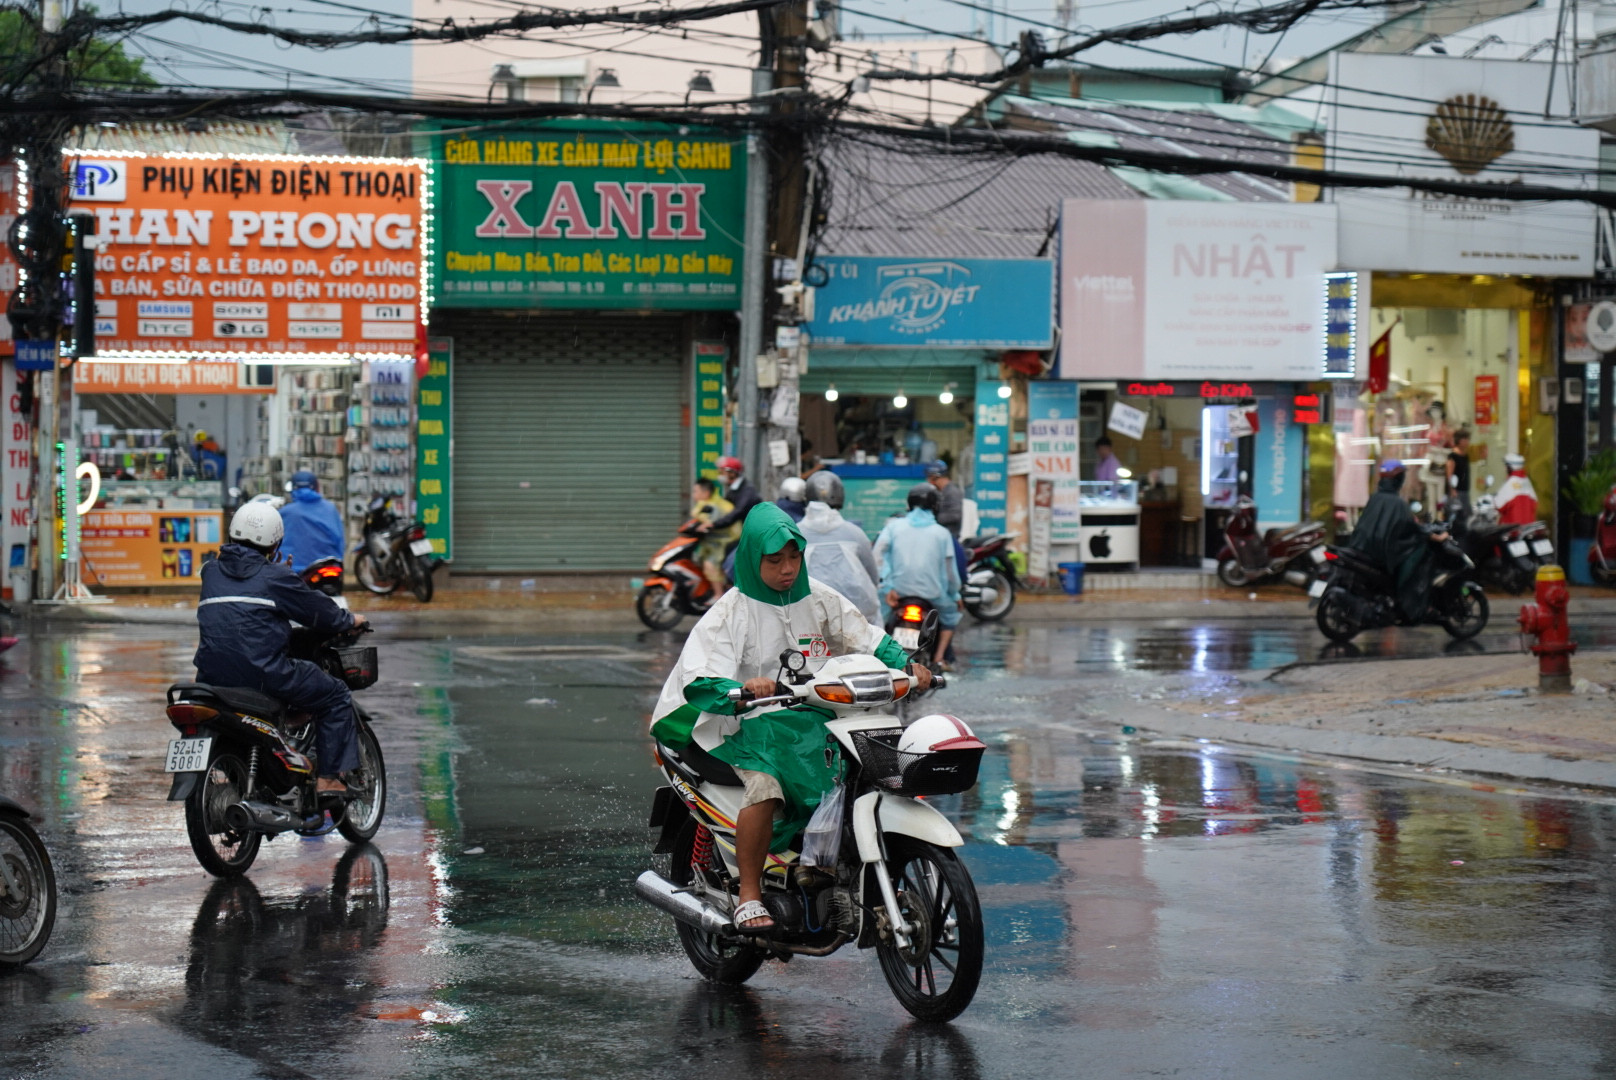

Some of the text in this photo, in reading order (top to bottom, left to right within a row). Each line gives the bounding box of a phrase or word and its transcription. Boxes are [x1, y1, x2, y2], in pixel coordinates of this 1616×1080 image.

[484, 135, 533, 165] HÀNG
[537, 142, 560, 166] XE
[603, 140, 639, 167] MÁY
[678, 141, 731, 169] SANH
[143, 162, 415, 203] PHỤ KIỆN ĐIỆN THOẠI
[476, 180, 705, 239] XANH
[66, 207, 416, 250] HAN PHONG
[121, 250, 166, 272] CẤP
[196, 257, 211, 274] &
[247, 258, 288, 275] BAO
[292, 259, 325, 278] DA,
[330, 254, 359, 276] ỐP
[363, 258, 416, 277] LƯNG
[446, 251, 491, 273] Chuyên
[553, 253, 580, 272] Trao
[663, 254, 680, 274] Xe
[1172, 233, 1306, 285] NHẬT
[111, 276, 158, 298] BÁN,
[163, 275, 204, 297] SỬA
[209, 279, 265, 298] CHỮA
[272, 279, 320, 300] ĐIỆN
[324, 281, 385, 302] THOẠI
[139, 304, 191, 315] SAMSUNG
[215, 306, 265, 315] SONY
[143, 324, 341, 335] htc LG oppo
[93, 364, 120, 388] PHỤ
[125, 363, 153, 388] KIỆN
[159, 364, 191, 389] ĐIỆN
[195, 364, 234, 389] THOẠI
[424, 449, 439, 465] XE
[1034, 455, 1072, 474] SIM
[1270, 408, 1288, 497] vinaphone
[170, 756, 202, 770] 5080
[672, 773, 698, 802] Wave
